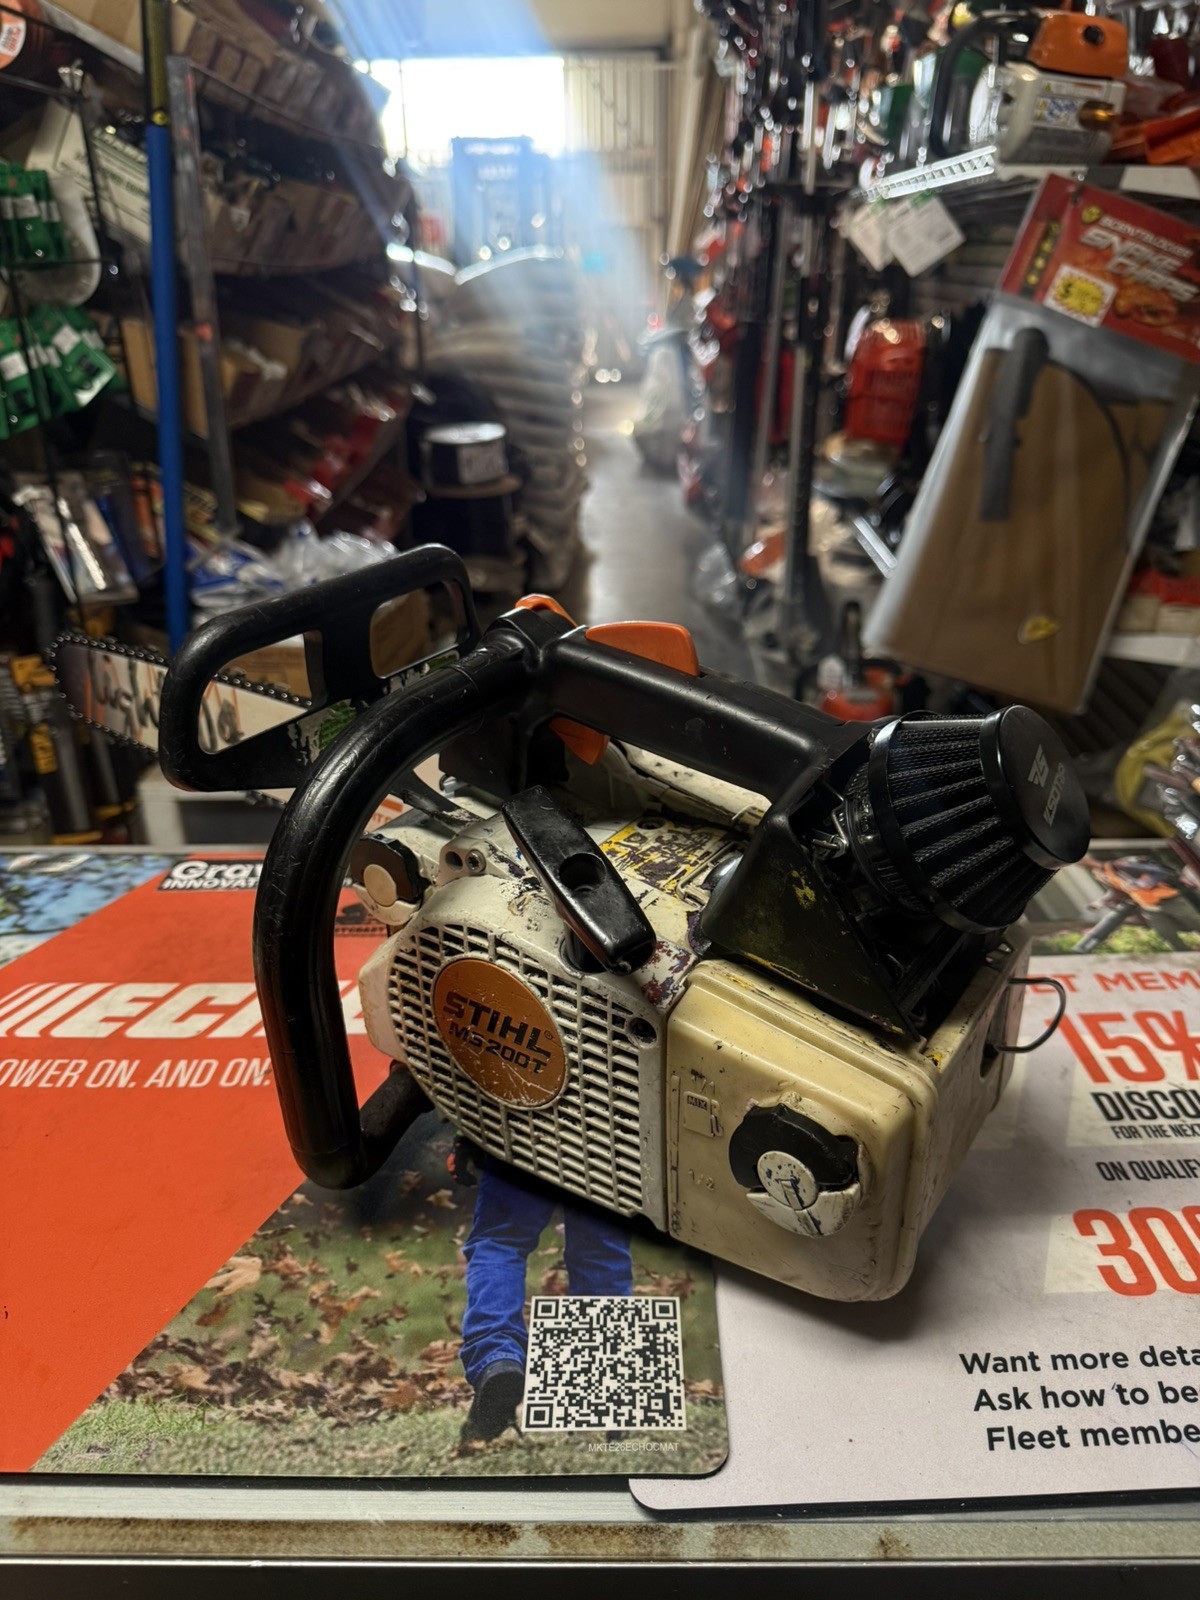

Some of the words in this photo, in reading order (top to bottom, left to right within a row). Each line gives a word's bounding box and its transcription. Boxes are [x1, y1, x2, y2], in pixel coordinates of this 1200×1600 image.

[1080, 227, 1183, 275] SNAKE
[1105, 256, 1199, 302] CHAPS
[1025, 973, 1077, 994] ET
[1093, 969, 1200, 992] MEM
[443, 991, 551, 1059] STIHL
[1044, 1011, 1200, 1083] 15%
[85, 1058, 145, 1088] ON.
[144, 1058, 216, 1088] AND
[218, 1057, 271, 1087] ON.
[687, 1095, 708, 1110] MIX
[1111, 1125, 1142, 1139] FOR
[1139, 1124, 1171, 1138] THE
[1096, 1161, 1131, 1181] ON
[959, 1351, 1041, 1374] Want
[1050, 1351, 1129, 1370] more
[973, 1387, 1032, 1411] Ask
[1040, 1386, 1105, 1408] how
[1115, 1384, 1149, 1405] to
[1158, 1381, 1200, 1403] be
[986, 1425, 1070, 1451] Fleet
[1080, 1419, 1200, 1447] membe
